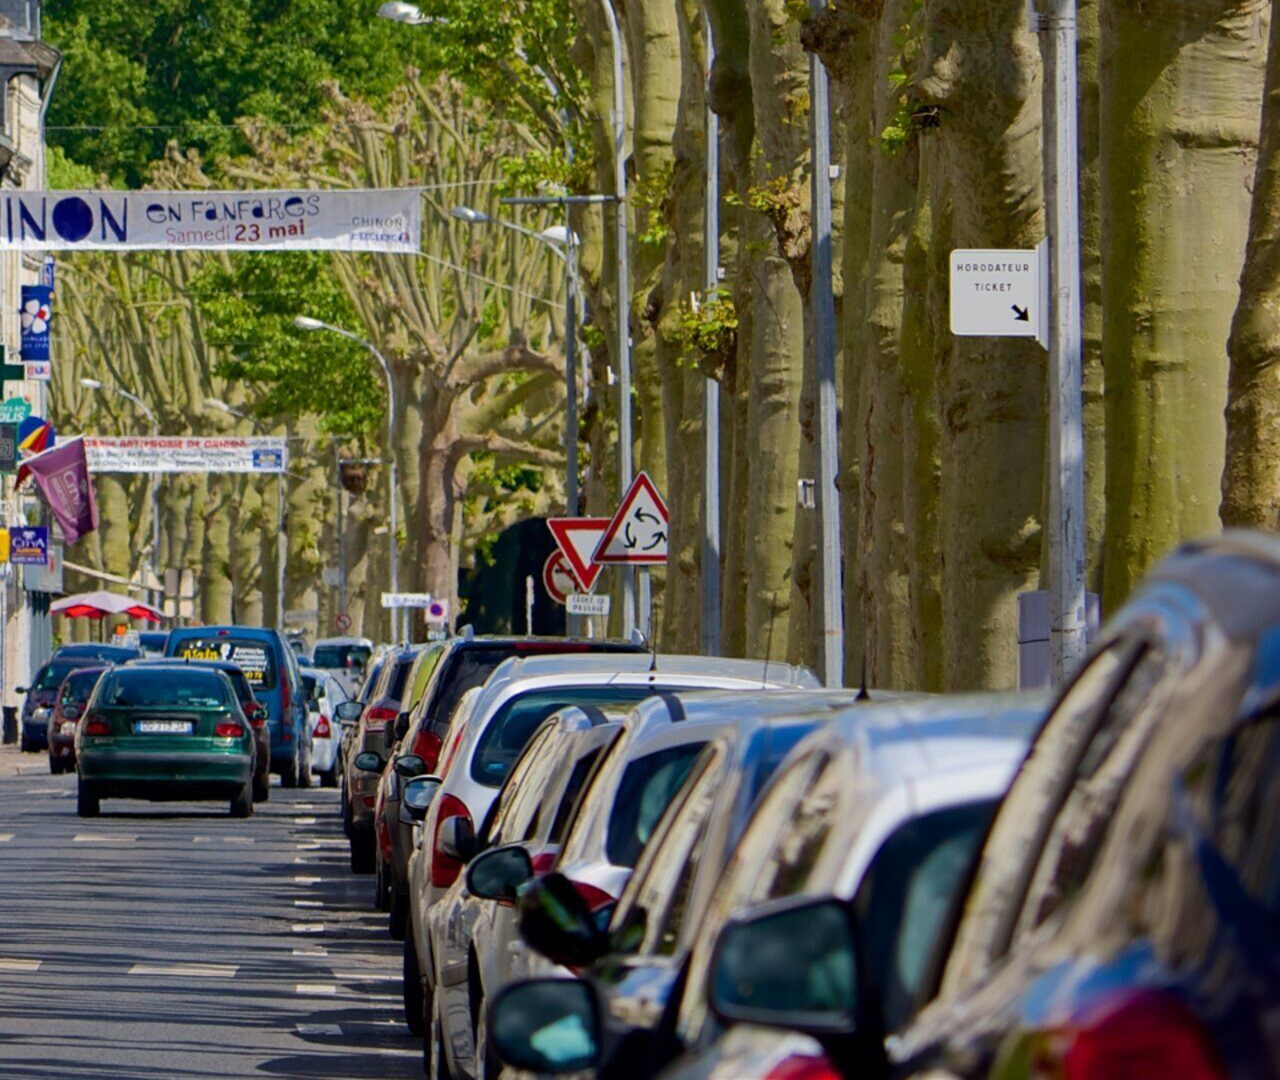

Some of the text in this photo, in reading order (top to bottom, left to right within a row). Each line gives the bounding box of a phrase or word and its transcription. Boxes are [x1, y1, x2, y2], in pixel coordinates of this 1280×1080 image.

[351, 216, 403, 228] CHINON
[165, 219, 305, 244] Samedi 23 mai
[956, 263, 1030, 272] HORODATEUR
[975, 283, 1013, 292] TICKET
